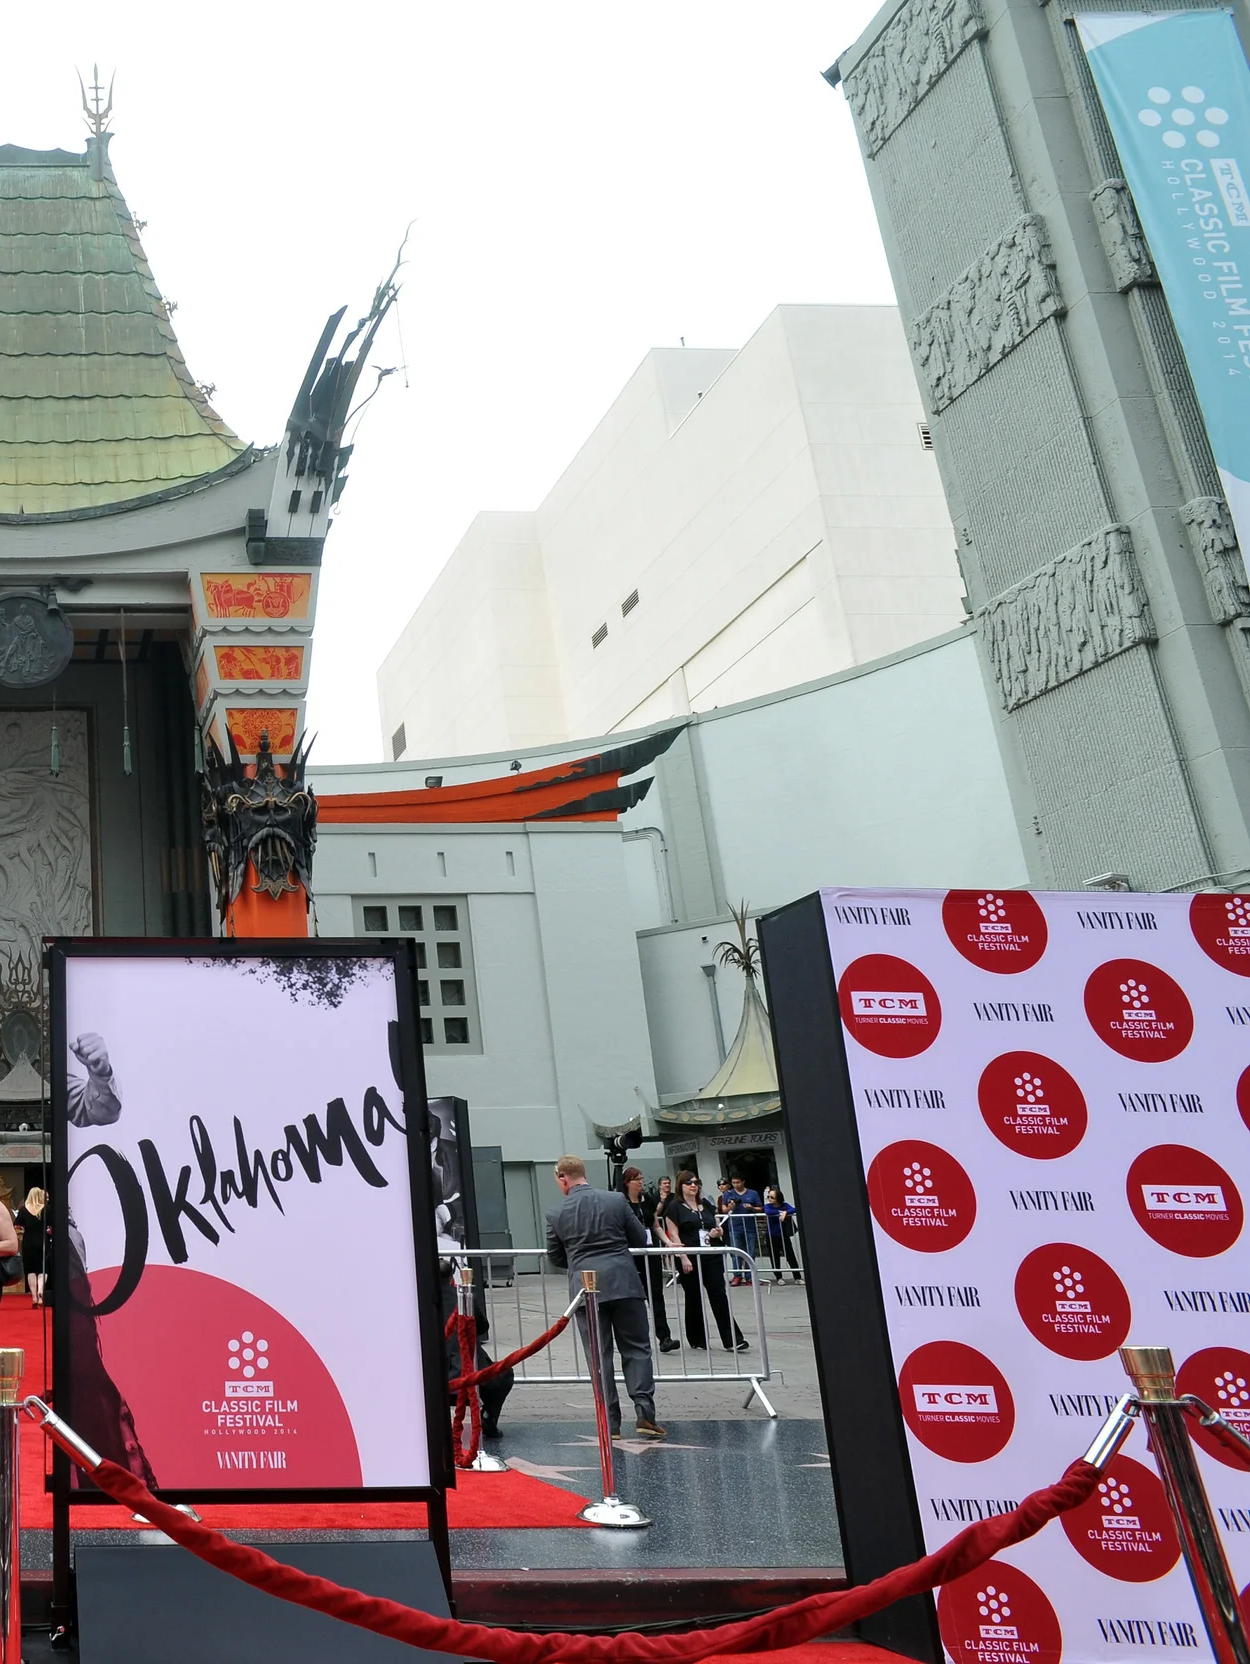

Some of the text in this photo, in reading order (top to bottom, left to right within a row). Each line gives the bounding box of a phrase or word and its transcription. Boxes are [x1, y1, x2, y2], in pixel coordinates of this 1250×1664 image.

[1219, 163, 1249, 222] TCM
[1180, 159, 1250, 316] CLASSIC FILM
[1162, 160, 1241, 376] HOLLYWOOD 2014
[834, 906, 911, 925] VANITY FAIR
[1076, 912, 1158, 930] VANITY FAIR
[968, 934, 1005, 942] CLASSIC
[859, 998, 919, 1009] TCM
[973, 1003, 1055, 1022] VANITY FAIR
[879, 1017, 906, 1025] CLASSIC
[907, 1017, 928, 1025] MOVIES
[1122, 1030, 1166, 1038] FESTIVAL
[863, 1090, 946, 1108] VANITY FAIR
[1117, 1094, 1204, 1112] VANITY FAIR
[1046, 1117, 1068, 1125] FILM
[1016, 1126, 1060, 1134] FESTIVAL
[710, 1132, 778, 1147] STARLINE TOURS
[907, 1197, 937, 1205] TCM
[1009, 1191, 1095, 1211] VANITY FAIR
[1151, 1192, 1217, 1204] TCM
[892, 1208, 931, 1216] CLASSIC
[1148, 1212, 1229, 1221] TURNER CLASSIC MOVIES
[903, 1218, 948, 1226] FESTIVAL
[894, 1286, 981, 1307] VANITY FAIR
[1042, 1314, 1110, 1323] CLASSIC FILM
[1054, 1324, 1101, 1333] FESTIVAL
[229, 1385, 271, 1393] TCM
[922, 1393, 989, 1405] TCM
[202, 1400, 298, 1413] CLASSIC FILM
[217, 1414, 283, 1427] FESTIVAL
[918, 1414, 1000, 1423] TURNER CLASSIC MOVIES
[217, 1451, 287, 1469] VANITY FAIR
[1104, 1518, 1138, 1526] TCM
[1088, 1530, 1161, 1541] CLASSIC FILM
[1102, 1541, 1152, 1552] FESTIVAL
[981, 1628, 1016, 1637] TCM
[1097, 1619, 1198, 1647] VANITY FAIR
[965, 1640, 1039, 1652] CLASSIC FILM
[978, 1652, 1030, 1663] FESTIVAL
